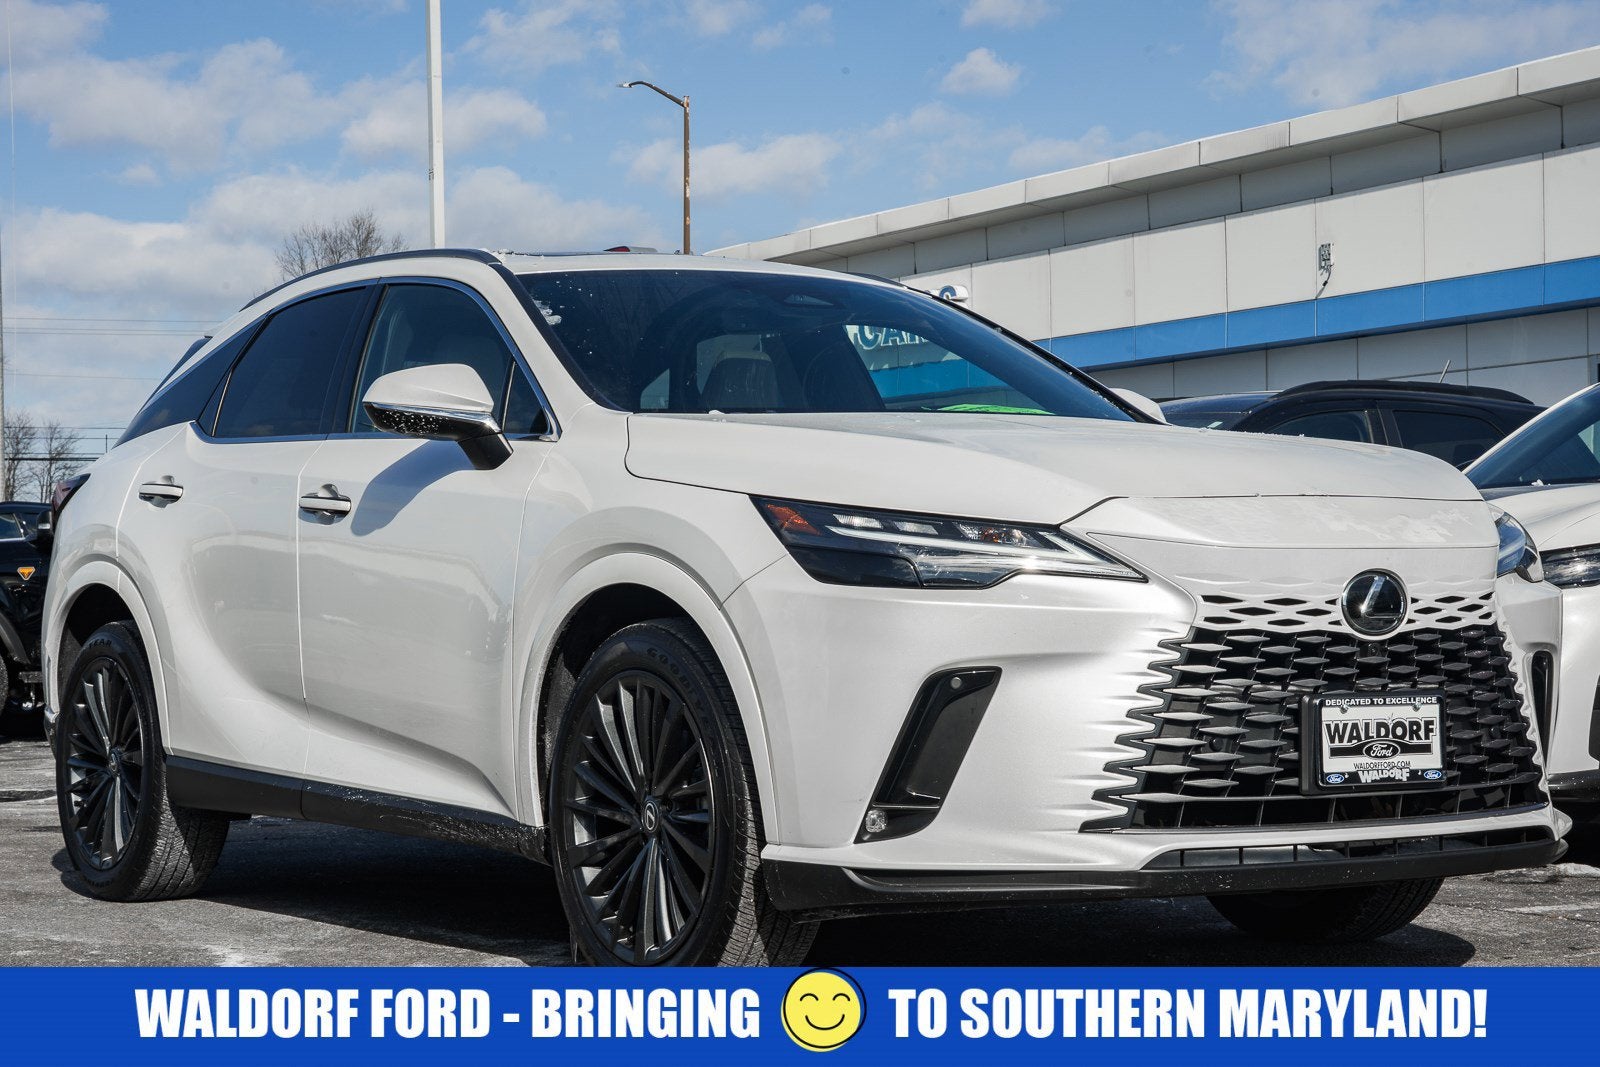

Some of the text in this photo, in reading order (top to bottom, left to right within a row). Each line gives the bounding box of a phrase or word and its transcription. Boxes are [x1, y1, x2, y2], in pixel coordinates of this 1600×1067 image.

[1325, 697, 1369, 706] DEDICATED
[1386, 696, 1437, 705] EXCELLENCE
[1324, 719, 1436, 744] WALDORF
[1370, 743, 1393, 757] Ford
[1353, 760, 1412, 770] WALDORFFORD.COM
[1357, 768, 1410, 783] WALDORF
